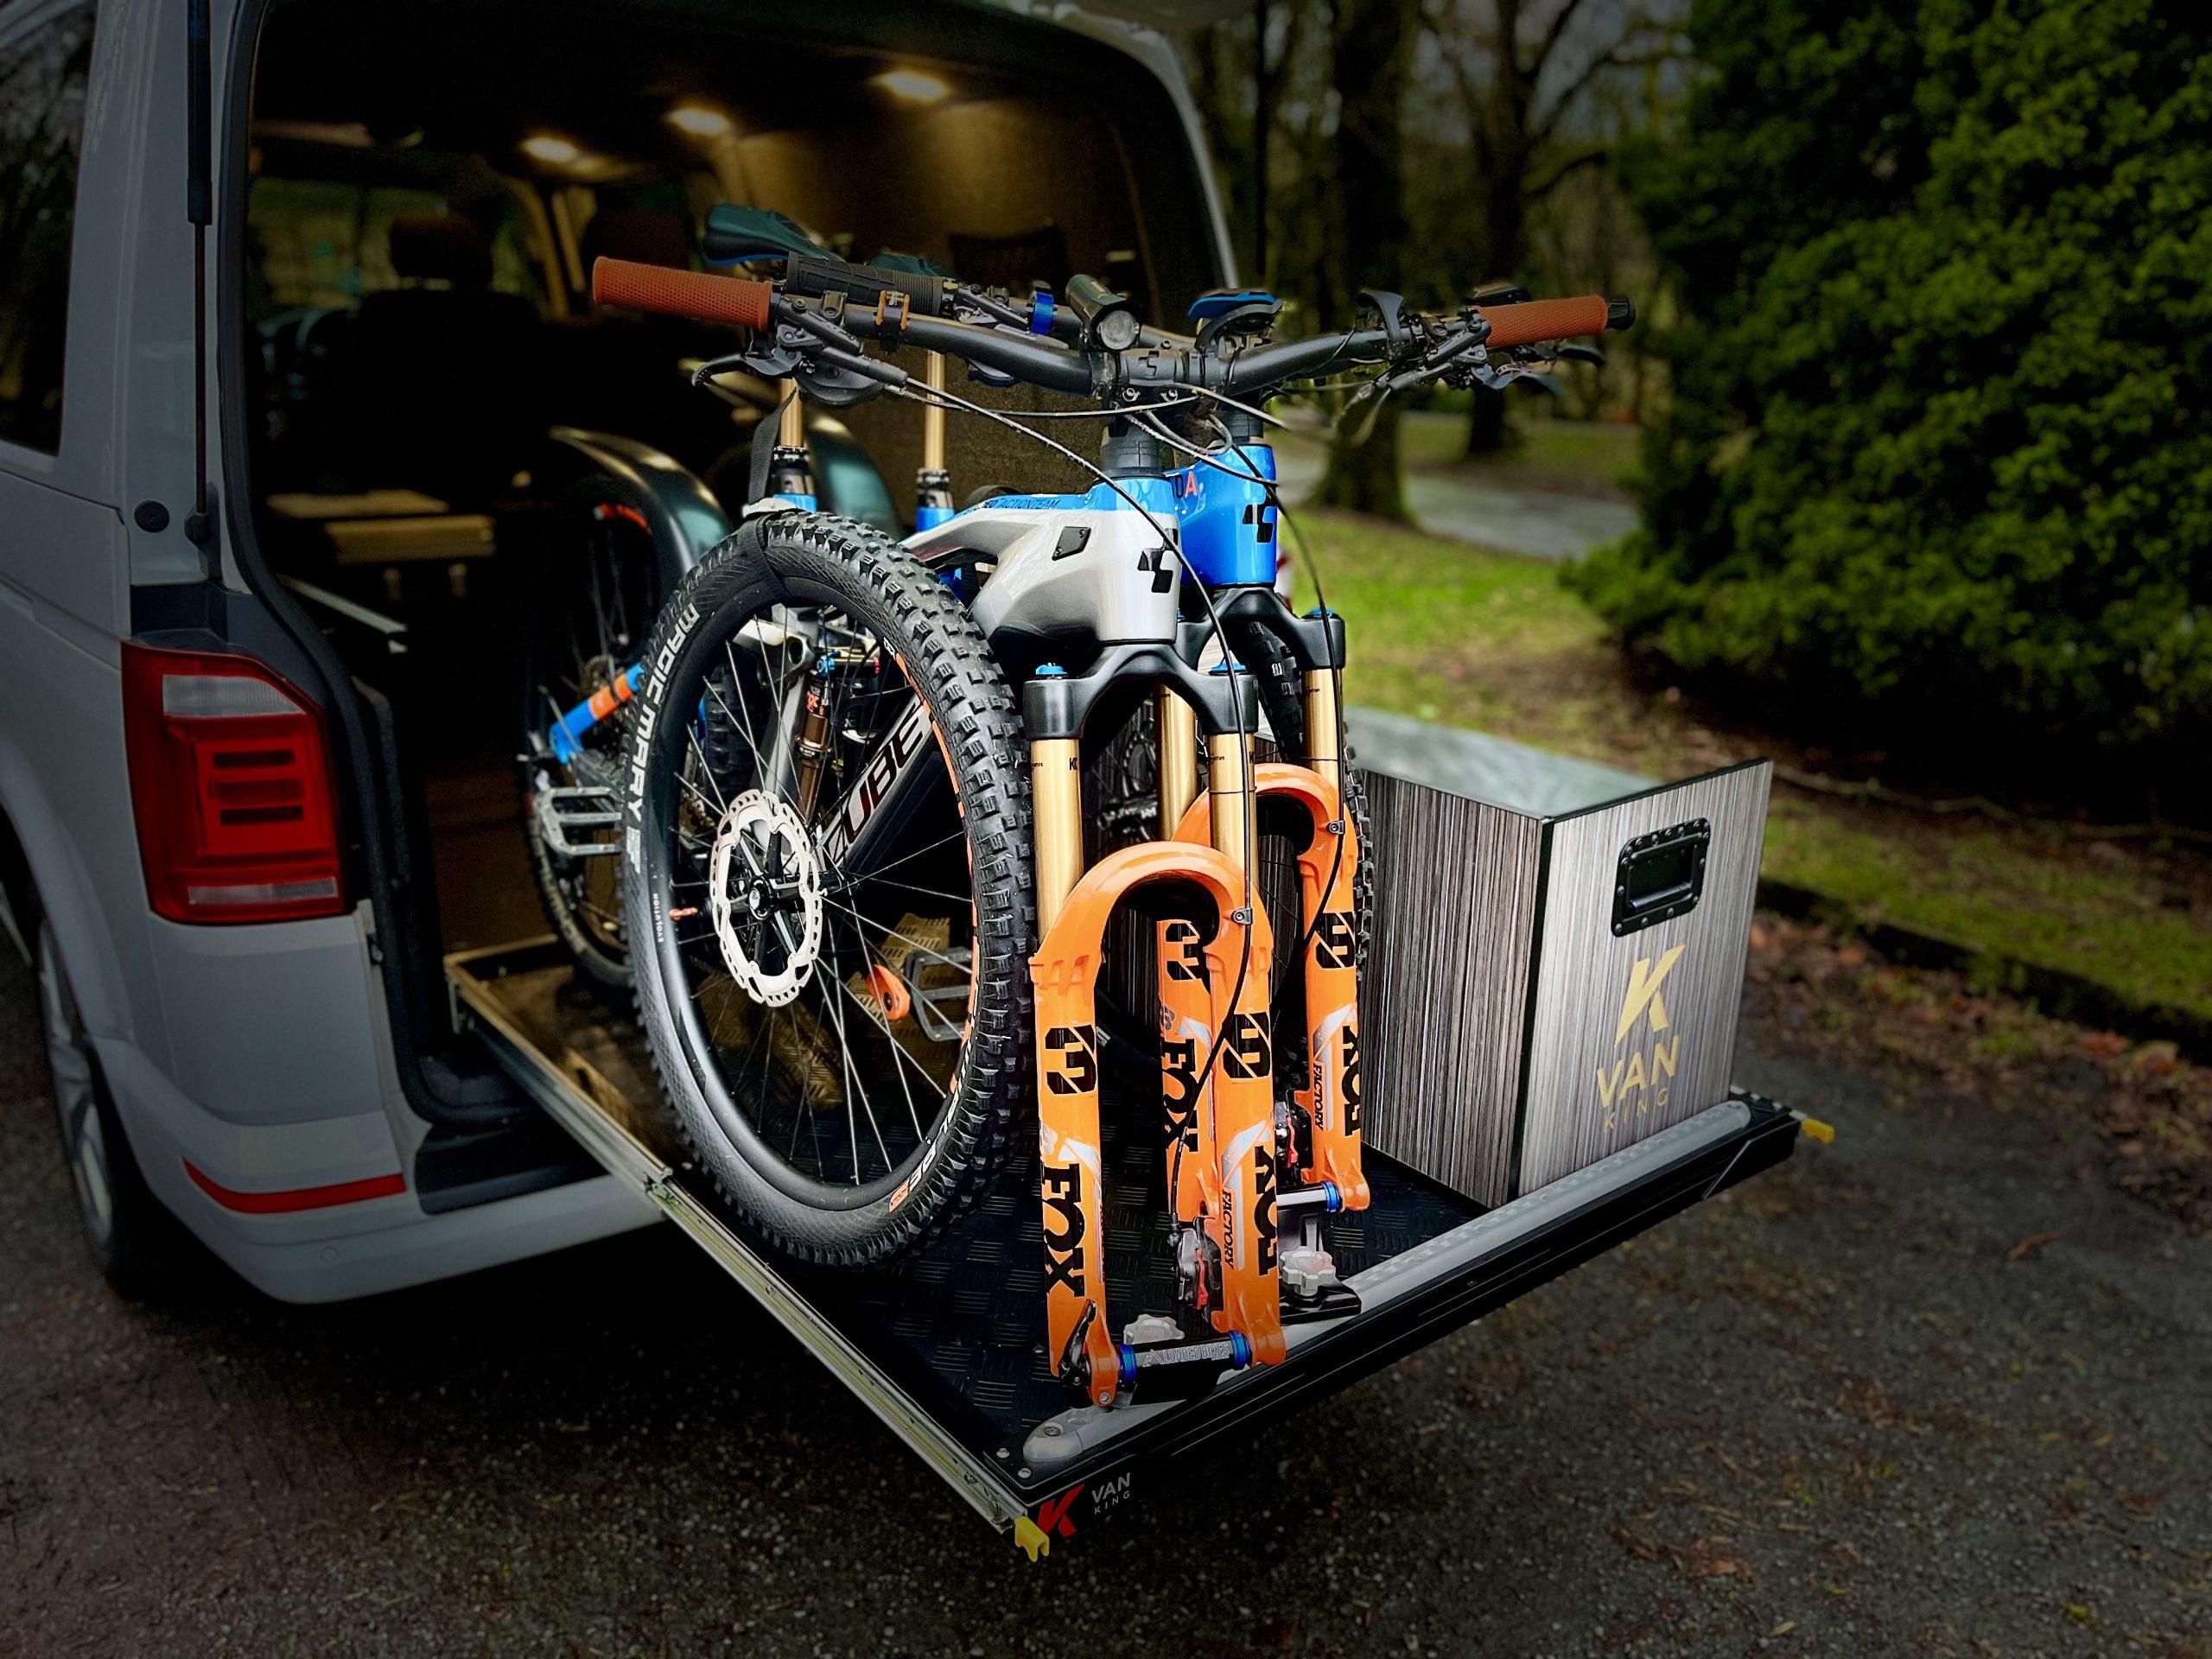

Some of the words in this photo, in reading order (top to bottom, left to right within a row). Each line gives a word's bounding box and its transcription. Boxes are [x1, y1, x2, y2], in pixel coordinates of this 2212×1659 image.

[646, 601, 700, 704] MAGIC
[628, 704, 656, 822] MARY
[823, 701, 923, 864] CUBE
[652, 893, 664, 943] EVOLUTION
[1614, 944, 1686, 1047] K
[1161, 1039, 1198, 1152] FOX
[1313, 1062, 1324, 1131] FACTORY
[1597, 1034, 1680, 1108] VAN
[1605, 1087, 1669, 1133] KING
[1041, 1164, 1086, 1297] FOX
[1222, 1189, 1235, 1271] FACTORY
[1038, 1484, 1085, 1537] K
[1091, 1472, 1130, 1503] VAN
[1094, 1491, 1130, 1515] KING
